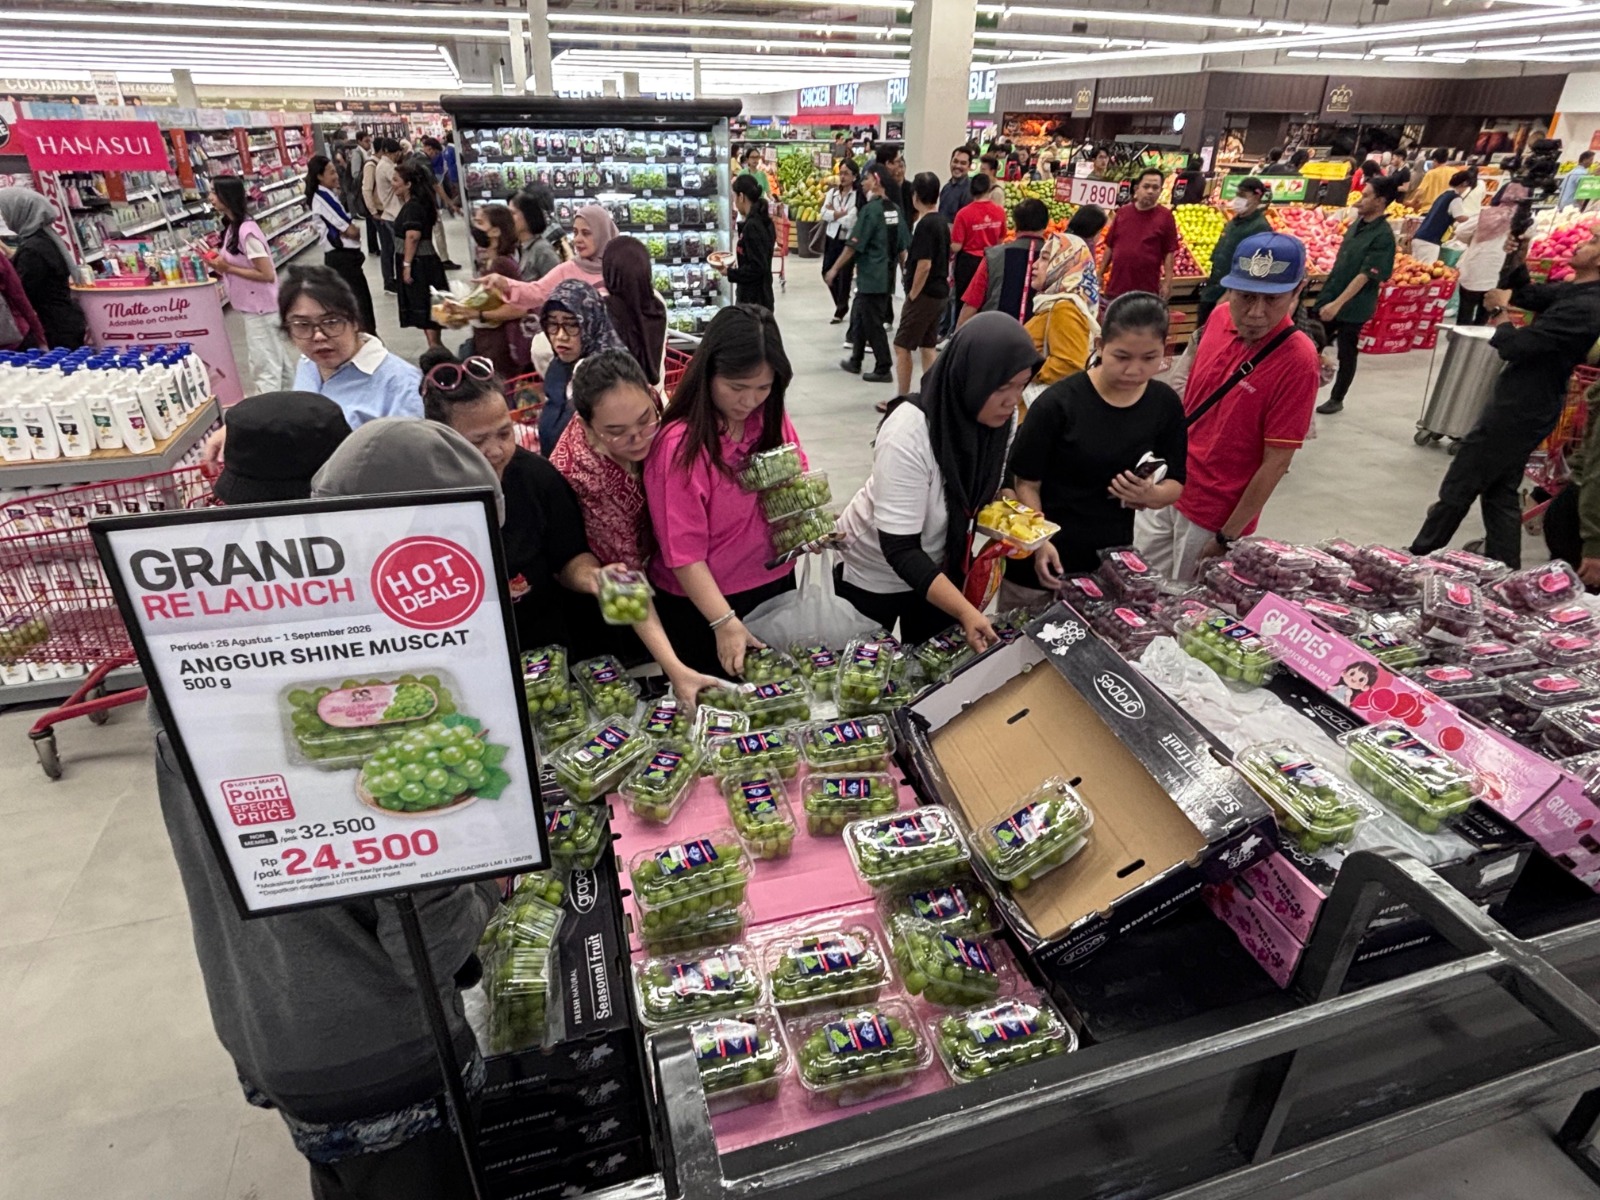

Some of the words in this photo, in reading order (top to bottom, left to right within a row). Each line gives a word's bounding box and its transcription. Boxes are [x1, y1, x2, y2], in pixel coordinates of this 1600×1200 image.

[344, 86, 376, 98] RICE
[800, 86, 831, 108] CHICKEN
[835, 83, 859, 106] MEAT
[887, 77, 908, 104] FRU
[968, 70, 996, 100] BLE
[36, 136, 152, 155] HANASUI
[1080, 183, 1116, 206] 7,890
[103, 301, 150, 318] Matte
[153, 304, 167, 313] on
[169, 297, 190, 314] Lip
[108, 317, 145, 328] Adorable
[147, 317, 157, 325] on
[158, 313, 188, 322] Cheeks
[129, 535, 346, 593] GRAND
[385, 554, 456, 596] HOT
[141, 592, 195, 621] RE
[198, 577, 356, 615] LAUNCH
[398, 577, 471, 614] DEALS
[170, 641, 209, 653] Periode
[216, 639, 229, 648] 26
[231, 635, 273, 648] Agustus
[284, 633, 290, 641] 1
[291, 628, 345, 643] September
[347, 624, 372, 635] 2026
[1263, 608, 1333, 660] GRAPES
[179, 649, 286, 675] ANGGUR
[291, 641, 365, 664] SHINE
[369, 629, 471, 657] MUSCAT
[182, 677, 217, 691] 500
[219, 679, 232, 690] g
[1307, 663, 1334, 682] GRAPES
[1096, 673, 1143, 714] grapes
[1161, 732, 1191, 761] fruit
[228, 785, 285, 803] Point
[1184, 760, 1240, 814] Seaonal
[232, 800, 288, 814] SPECIAL
[235, 808, 291, 825] PRICE
[1546, 795, 1581, 827] GRAPES
[298, 816, 377, 840] 32.500
[243, 837, 275, 847] MEMBER
[260, 856, 279, 871] Rp
[281, 828, 440, 877] 24.500
[252, 865, 284, 882] /pak
[420, 868, 460, 879] RELAUNCH
[576, 869, 595, 907] grape
[1119, 921, 1131, 934] AS
[1130, 906, 1160, 929] SWEET
[1172, 882, 1203, 903] HONEY
[1390, 902, 1409, 912] SWE
[588, 933, 602, 959] fruit
[1041, 940, 1072, 960] FRESH
[1073, 918, 1110, 943] NATURAL
[1062, 932, 1108, 963] grapes
[1404, 935, 1431, 949] HONEY
[570, 968, 578, 998] NATURAL
[591, 958, 610, 1019] Seasonal
[574, 998, 582, 1025] FRESH
[483, 1082, 502, 1094] EET
[515, 1073, 548, 1088] HONEY
[527, 1109, 557, 1123] HONEY
